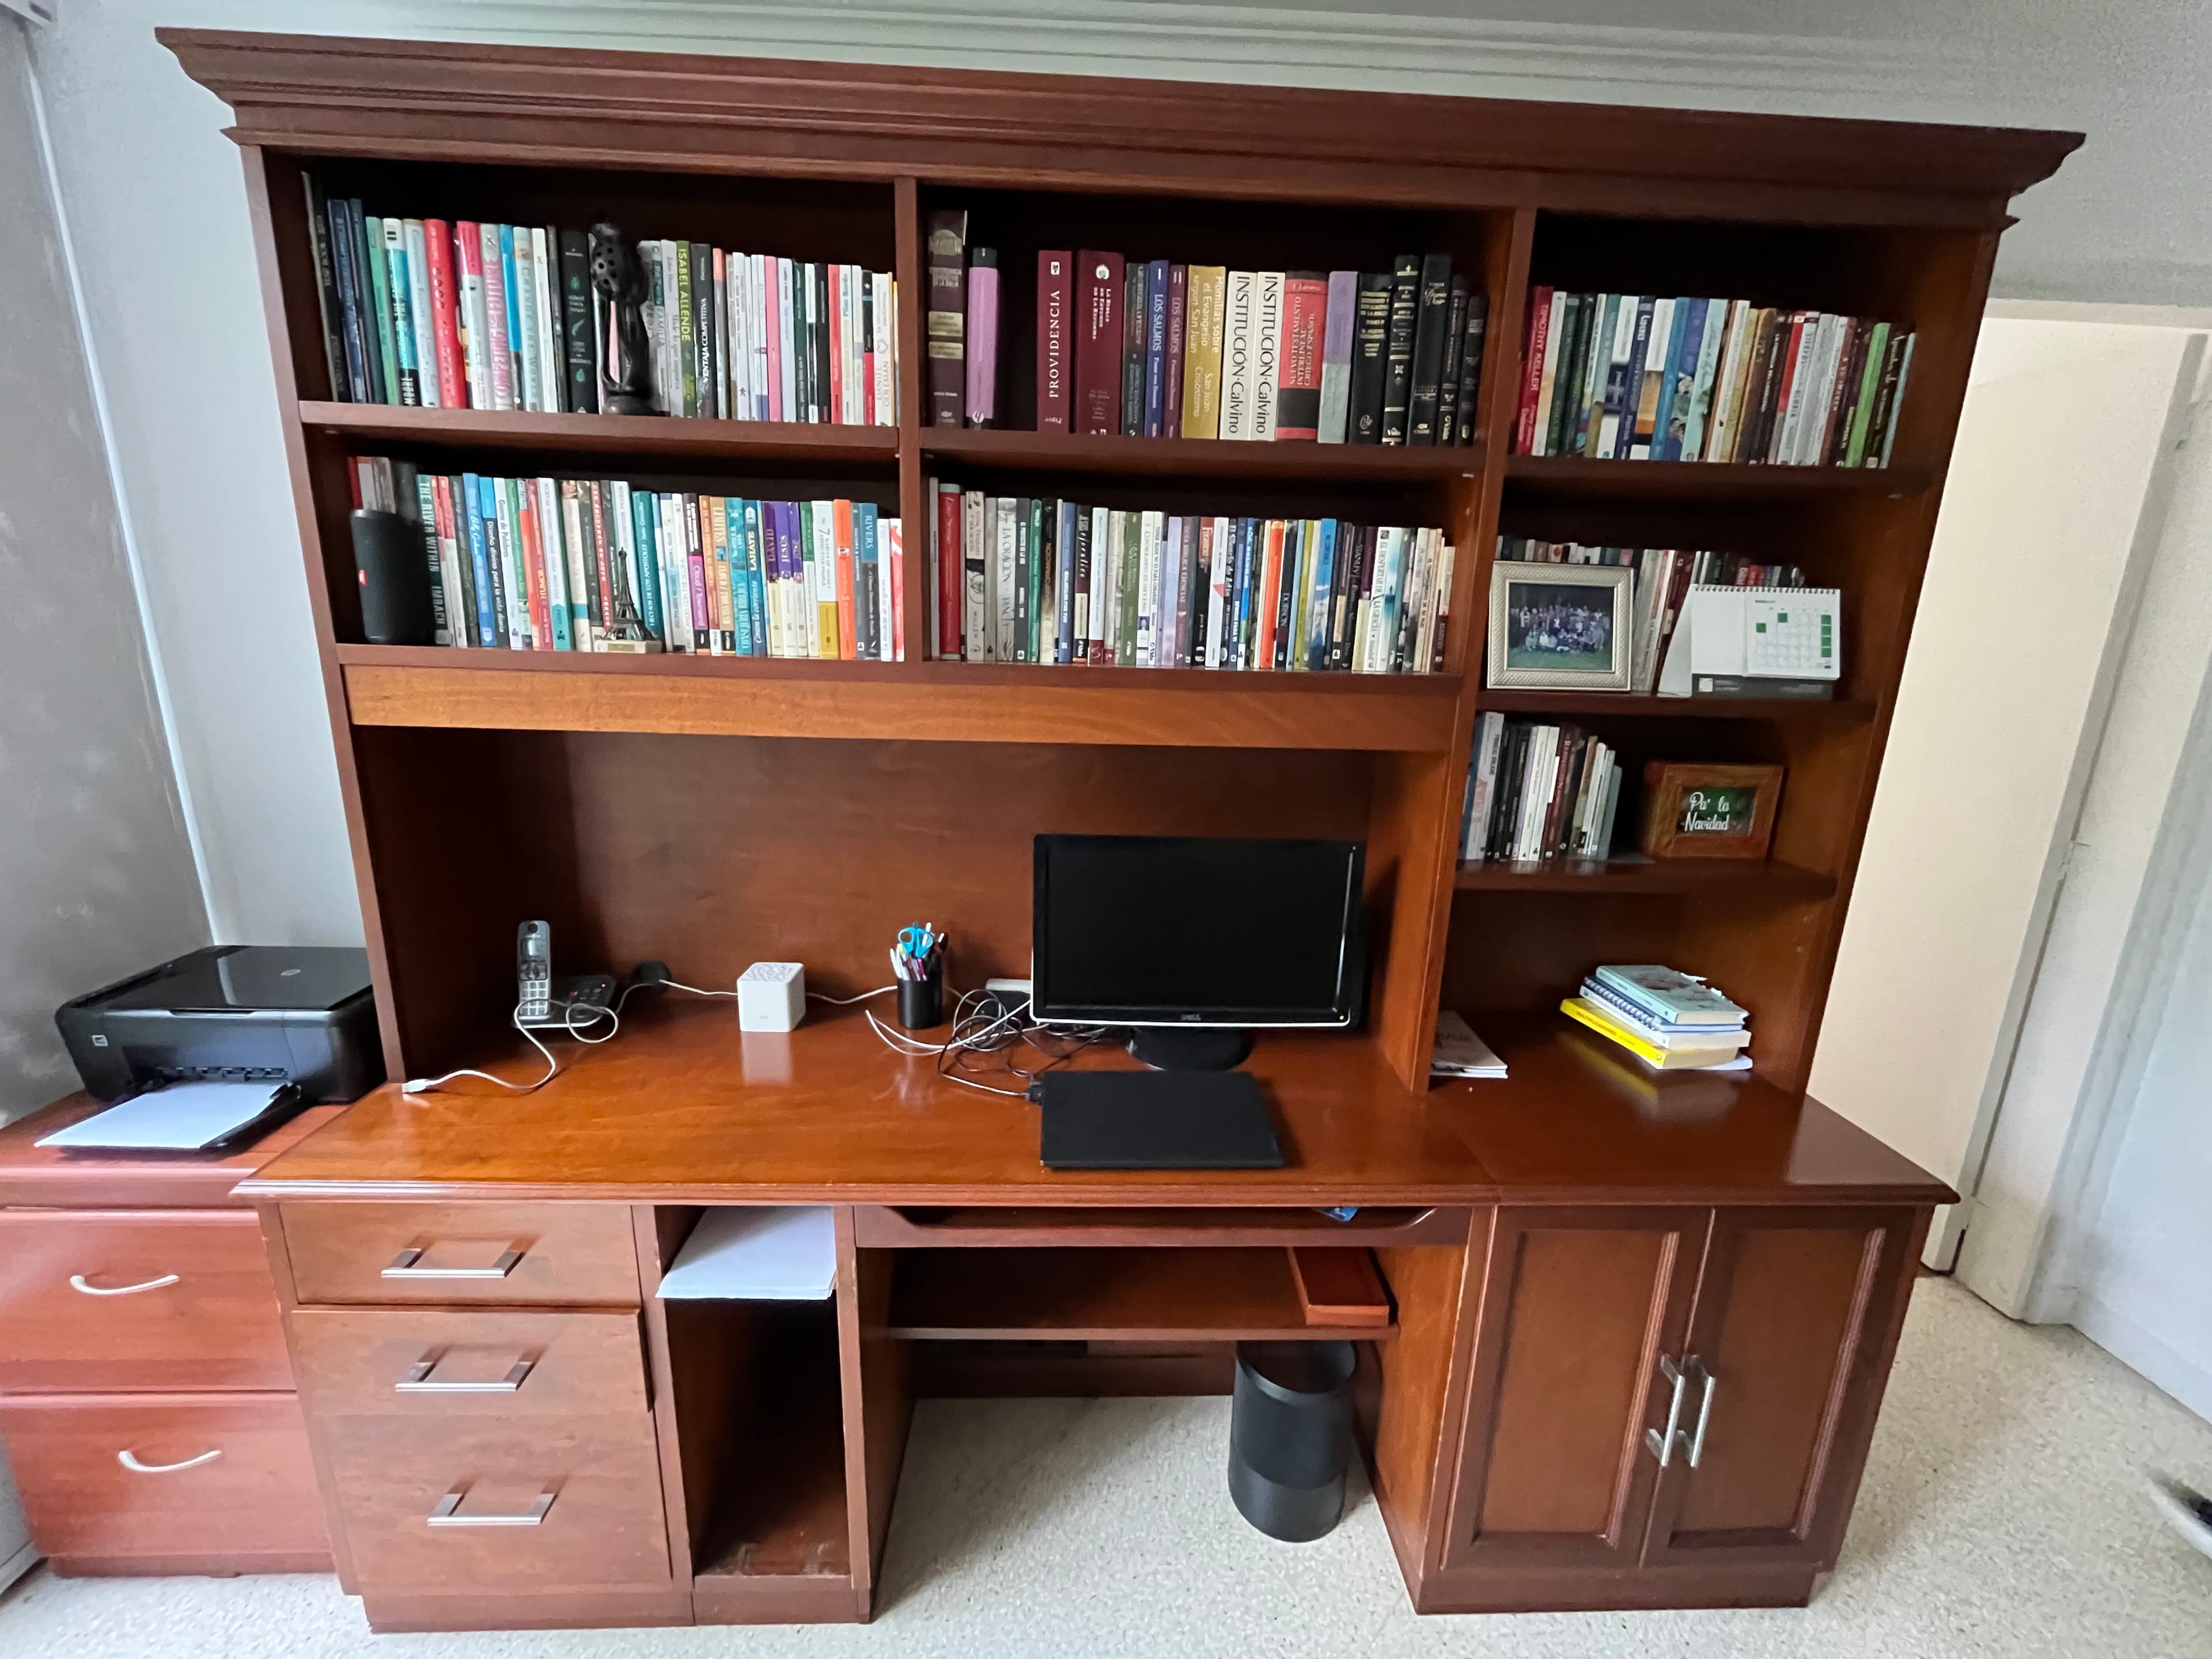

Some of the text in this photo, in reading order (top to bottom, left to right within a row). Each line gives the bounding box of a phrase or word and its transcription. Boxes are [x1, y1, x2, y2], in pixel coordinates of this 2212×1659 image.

[678, 248, 691, 342] ISABEL ALLENDE
[1153, 293, 1164, 311] LOS
[1171, 297, 1181, 315] LOS
[654, 306, 665, 348] FAMILIA
[1190, 308, 1200, 354] San Juan
[1200, 282, 1212, 347] el Evangelio
[1291, 296, 1302, 354] TESTAMENTO
[1536, 304, 1549, 350] TIMOTHY
[701, 298, 710, 383] VENTAJA COMPETITIVA
[1049, 290, 1060, 398] PROVIDENCIA
[1152, 314, 1162, 352] SALMOS
[1170, 317, 1180, 354] SALMOS
[1212, 325, 1221, 353] sobre
[1229, 276, 1250, 433] INSTITUCIÓN Calvino
[1256, 276, 1278, 433] INSTITUCIÓN Calvino
[1297, 328, 1306, 385] INTERLINEAL
[1304, 352, 1313, 386] GRIEGO
[1204, 373, 1212, 389] San
[1530, 353, 1543, 391] KELLER
[766, 529, 775, 562] DAVID
[865, 515, 873, 548] RIVERS
[1002, 528, 1011, 540] LA
[1226, 531, 1236, 564] Silencio
[419, 482, 445, 624] THE RIVER WITHIN IMBACH
[490, 547, 498, 569] divino
[748, 531, 756, 571] LAHAYE
[780, 535, 789, 562] JESUS
[1353, 544, 1363, 575] STANLEY
[491, 570, 499, 588] para
[1226, 565, 1233, 575] de
[1376, 550, 1387, 584] DESPERTAR
[1225, 576, 1233, 597] Adán
[1375, 585, 1383, 594] DE
[495, 596, 503, 612] vida
[695, 592, 705, 626] Townsend
[1371, 609, 1380, 631] GRACIA
[1373, 600, 1381, 608] LA
[497, 612, 505, 632] diaria
[1690, 791, 1730, 813] Pa' la
[1684, 812, 1730, 831] Navidad
